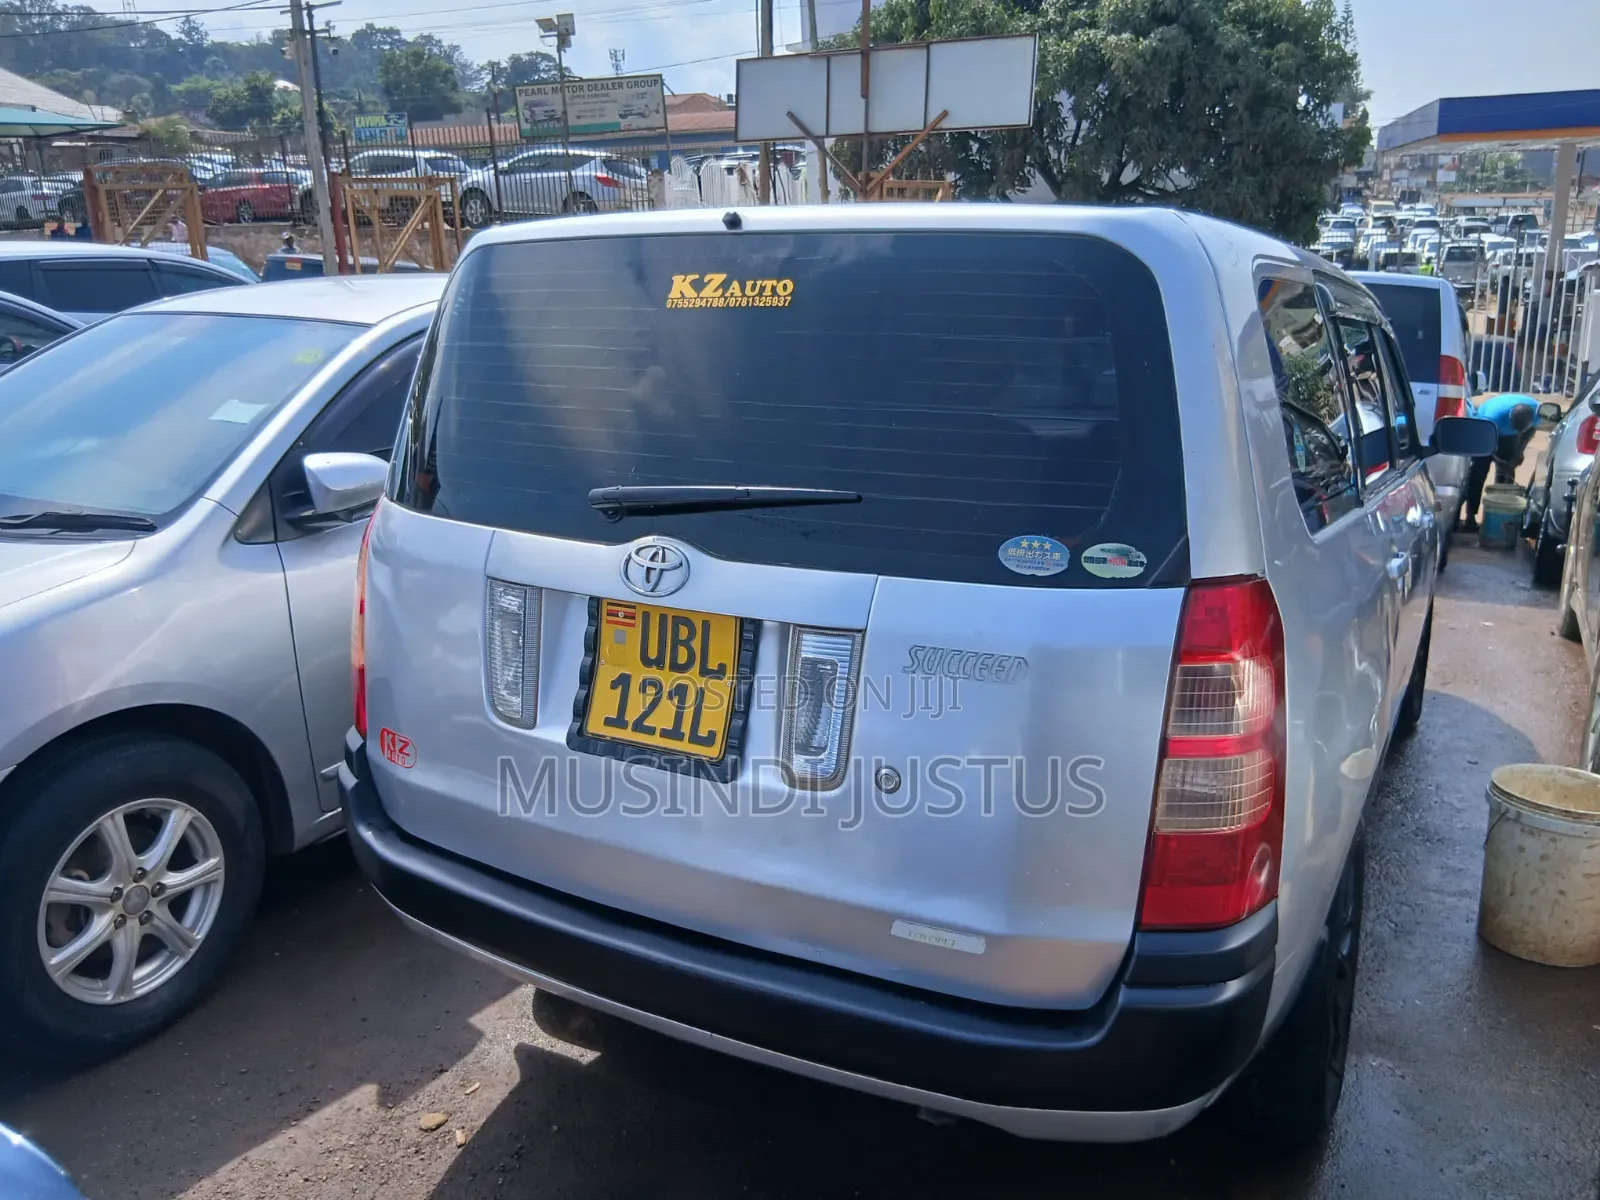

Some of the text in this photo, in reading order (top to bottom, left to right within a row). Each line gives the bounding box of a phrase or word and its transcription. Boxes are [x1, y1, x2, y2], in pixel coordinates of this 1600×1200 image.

[518, 86, 548, 97] PEARL
[587, 81, 624, 92] DEALER
[626, 79, 659, 90] GROUP
[724, 279, 794, 297] AUTO
[639, 610, 727, 681] UBL
[901, 644, 1029, 684] SUCCEED
[602, 672, 717, 748] 121L
